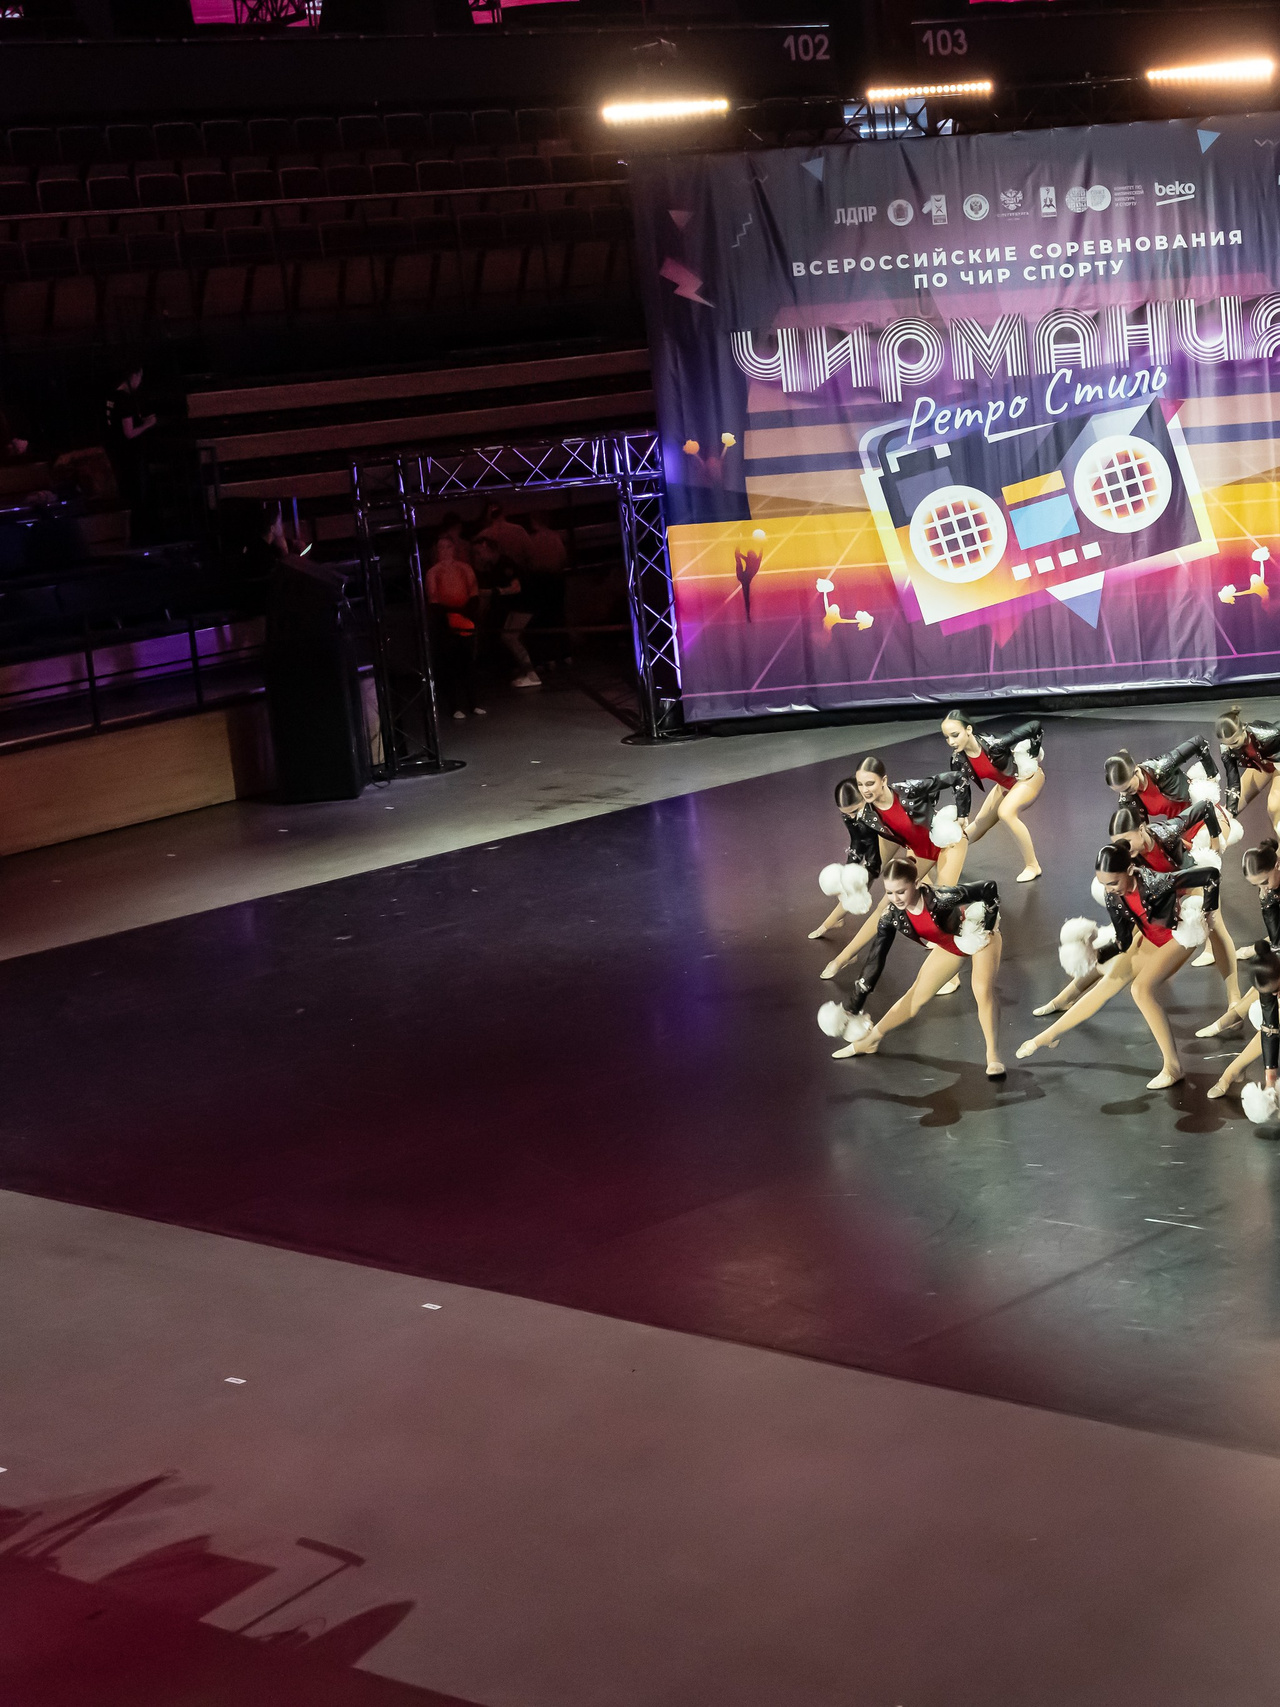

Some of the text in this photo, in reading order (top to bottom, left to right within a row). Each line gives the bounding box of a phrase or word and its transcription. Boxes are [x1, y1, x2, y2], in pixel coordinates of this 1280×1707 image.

[783, 33, 830, 62] 102
[922, 28, 969, 56] 103
[1154, 181, 1196, 196] beko
[834, 205, 878, 226] ЛДПР
[792, 229, 1244, 276] ВСЕРОССИЙСКИЕ СОРЕВНОВАНИЯ
[914, 259, 1125, 289] ПО ЧИР СПОРТУ
[907, 366, 1168, 445] Ретро Стиль
